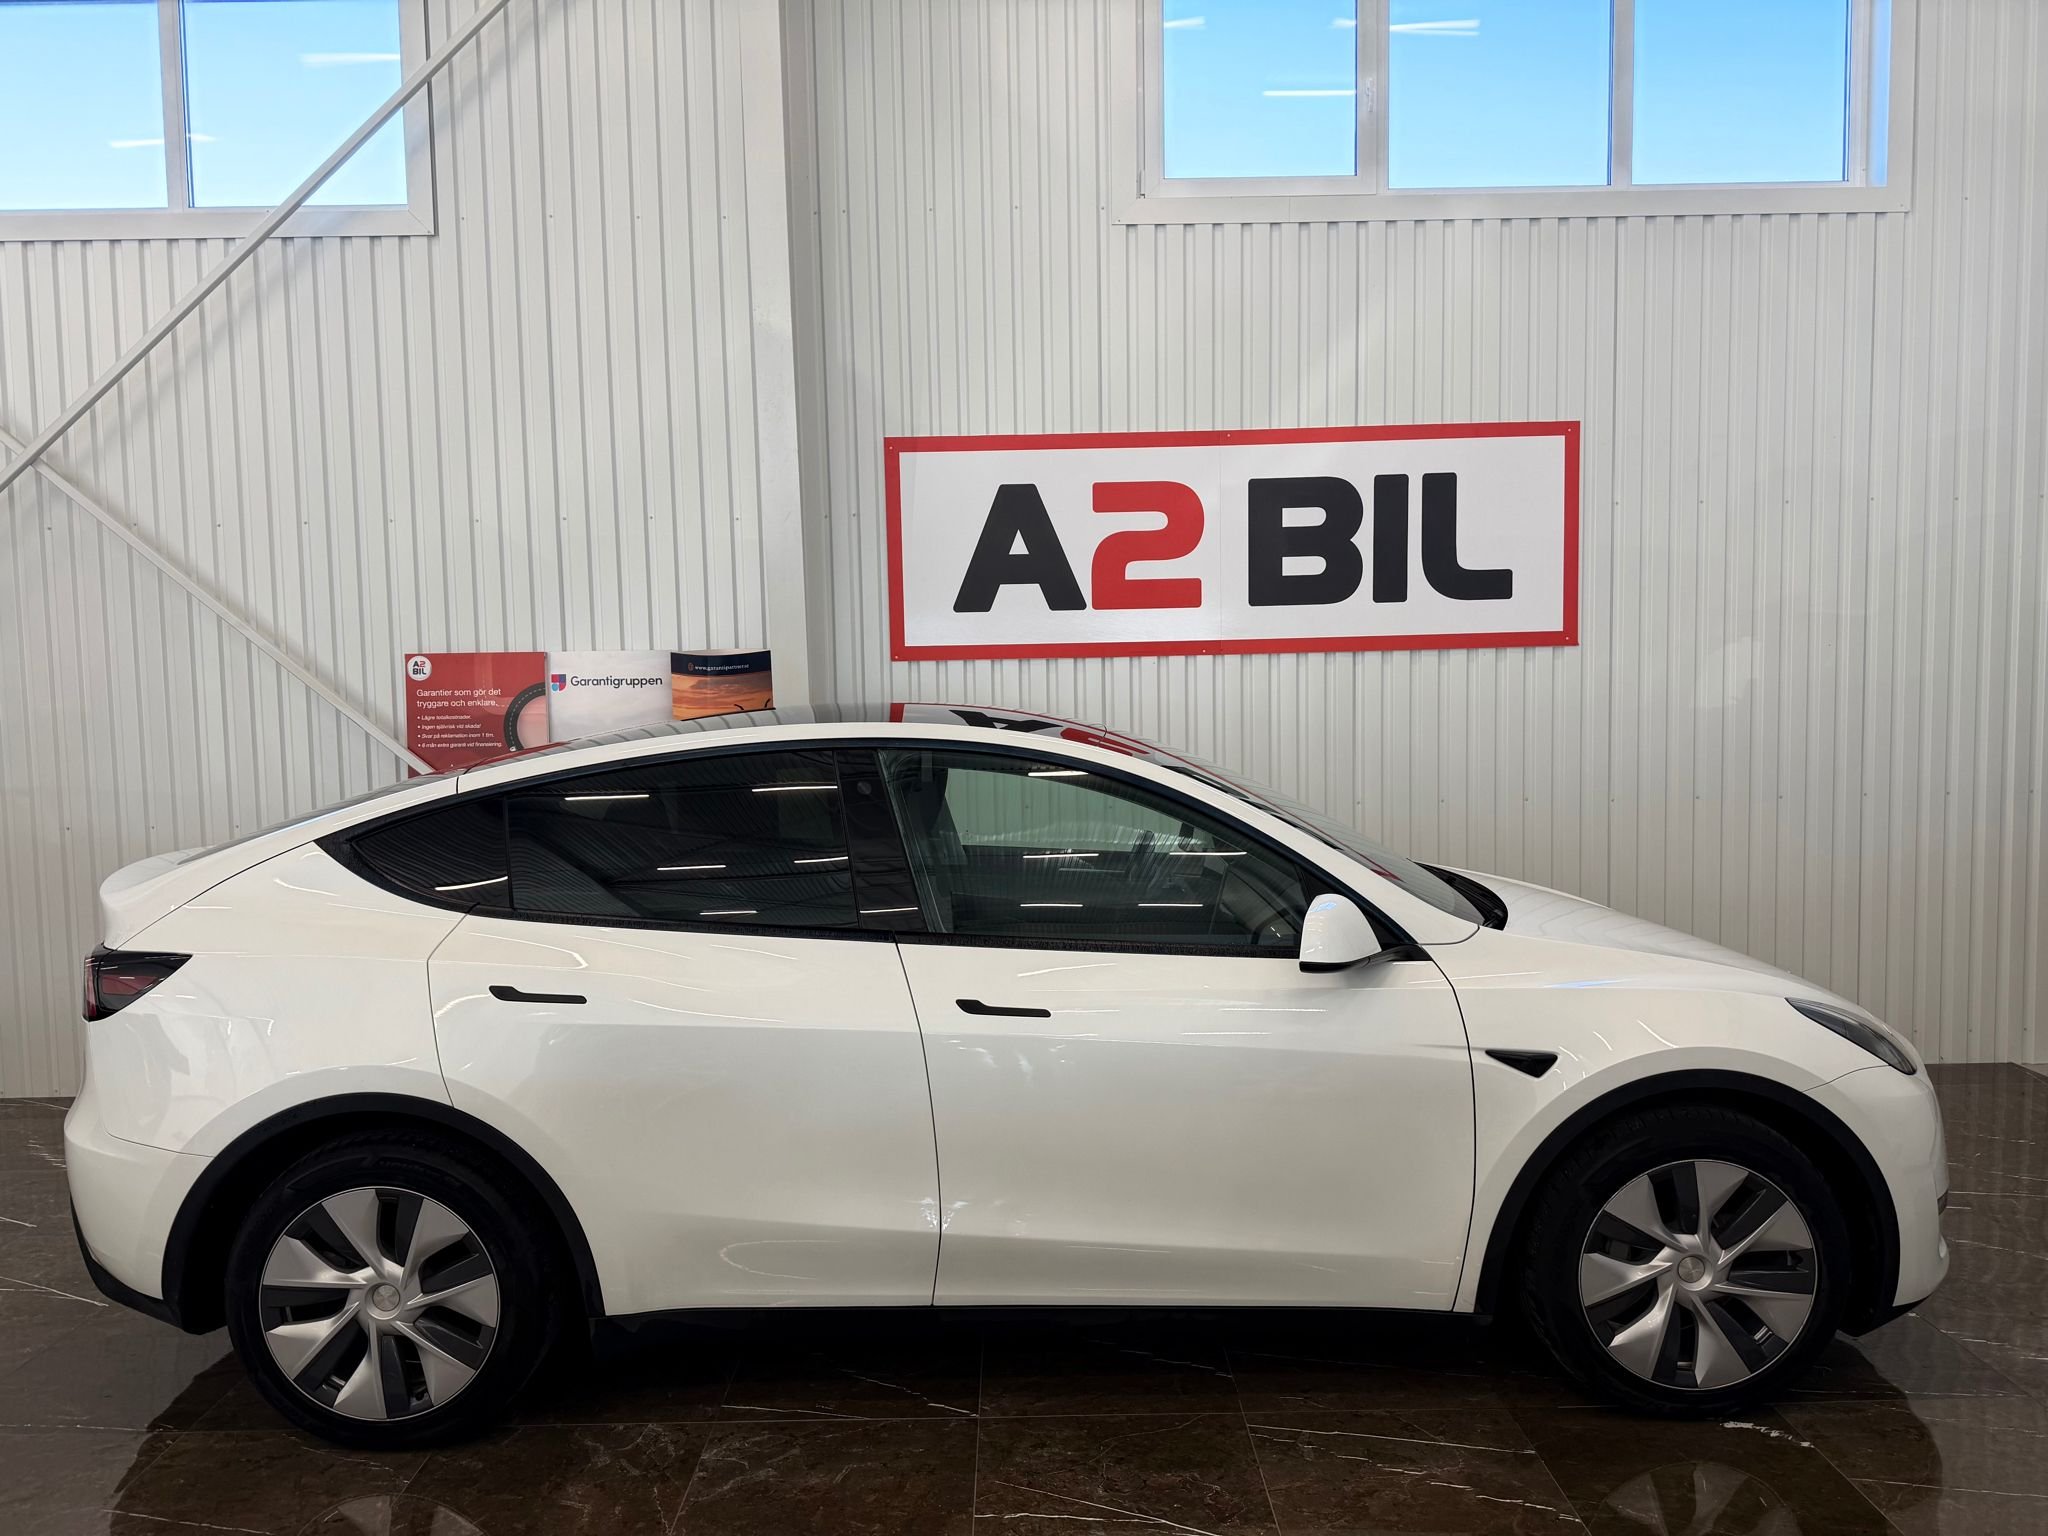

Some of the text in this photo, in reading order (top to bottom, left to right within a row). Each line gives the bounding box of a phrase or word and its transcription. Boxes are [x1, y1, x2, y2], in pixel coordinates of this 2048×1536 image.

[953, 472, 1513, 612] A2 BIL
[570, 676, 663, 689] Garantigruppen
[473, 689, 486, 698] gör
[417, 700, 448, 709] tryggare
